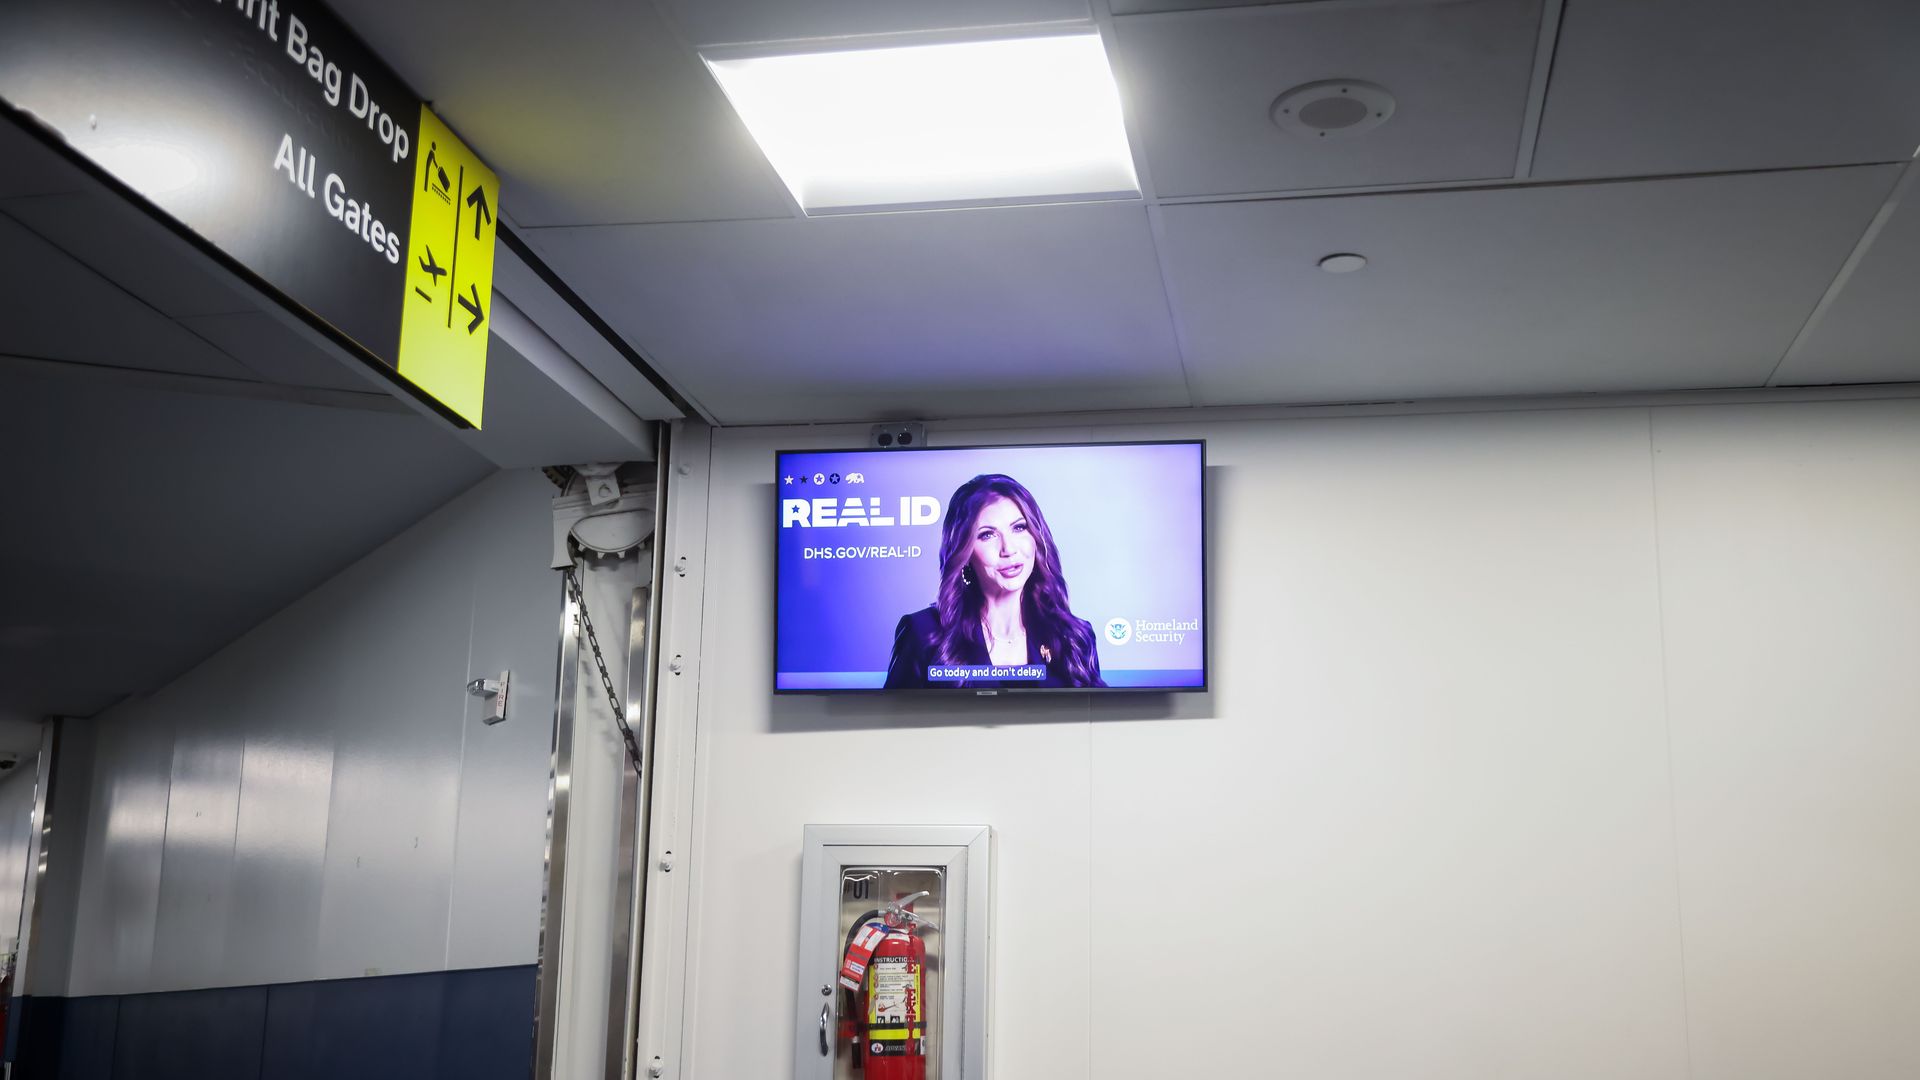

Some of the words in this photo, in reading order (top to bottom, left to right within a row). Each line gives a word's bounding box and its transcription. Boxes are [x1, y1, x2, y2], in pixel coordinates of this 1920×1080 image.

[287, 13, 342, 107] Bag
[349, 72, 410, 163] Drop
[274, 133, 316, 199] All
[324, 172, 400, 264] Gates
[782, 497, 895, 528] REAL
[900, 496, 941, 526] ID
[803, 546, 922, 560] DHS.GOV/REAL-ID
[1135, 618, 1198, 631] Homeland
[1135, 631, 1185, 645] Security
[929, 668, 943, 677] Go
[944, 667, 970, 679] today
[972, 667, 989, 677] and
[991, 667, 1015, 677] don't
[1017, 667, 1044, 678] delay.
